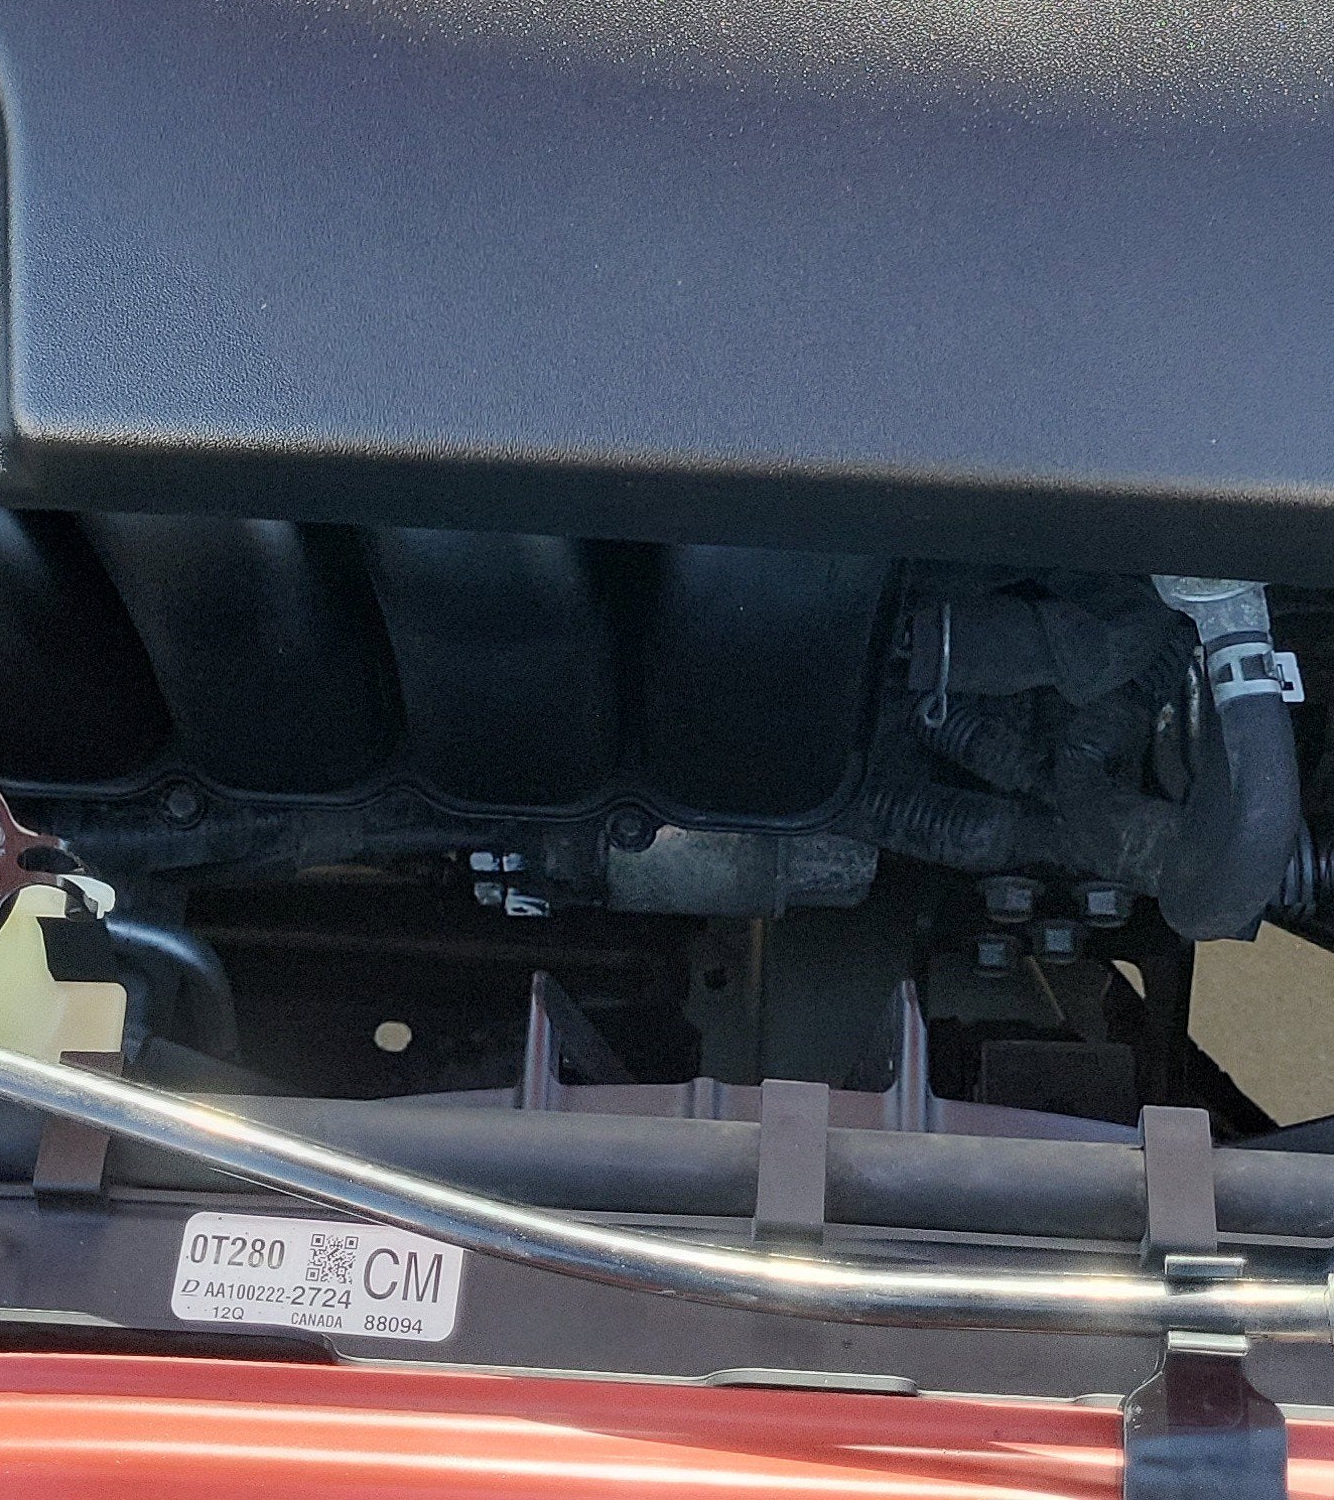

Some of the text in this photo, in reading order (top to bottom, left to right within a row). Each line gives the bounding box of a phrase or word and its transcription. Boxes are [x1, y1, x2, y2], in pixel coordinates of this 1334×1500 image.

[189, 1233, 444, 1304] 0T280 CM
[291, 1311, 344, 1330] CANADA
[363, 1314, 424, 1335] 88094
